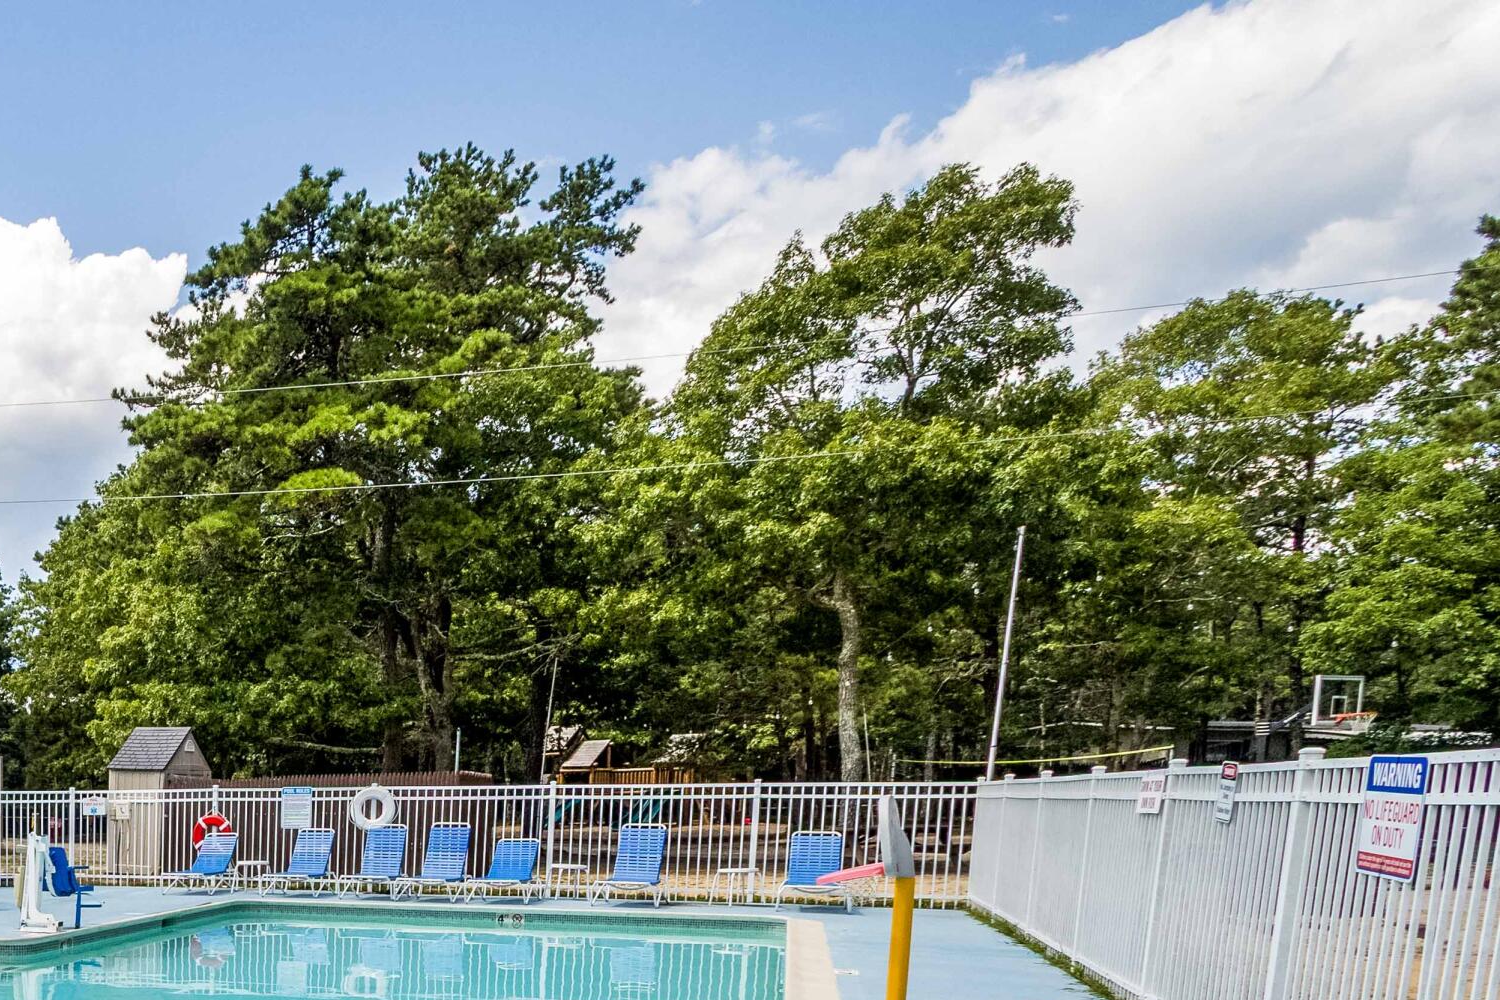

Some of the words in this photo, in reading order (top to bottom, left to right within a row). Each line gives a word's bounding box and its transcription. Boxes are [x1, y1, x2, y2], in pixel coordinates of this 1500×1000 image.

[1373, 762, 1422, 789] WARNING
[1364, 799, 1374, 820] NO
[1375, 800, 1419, 825] LIFEGUARD
[1372, 825, 1382, 846] ON
[1383, 826, 1404, 849] DUTY
